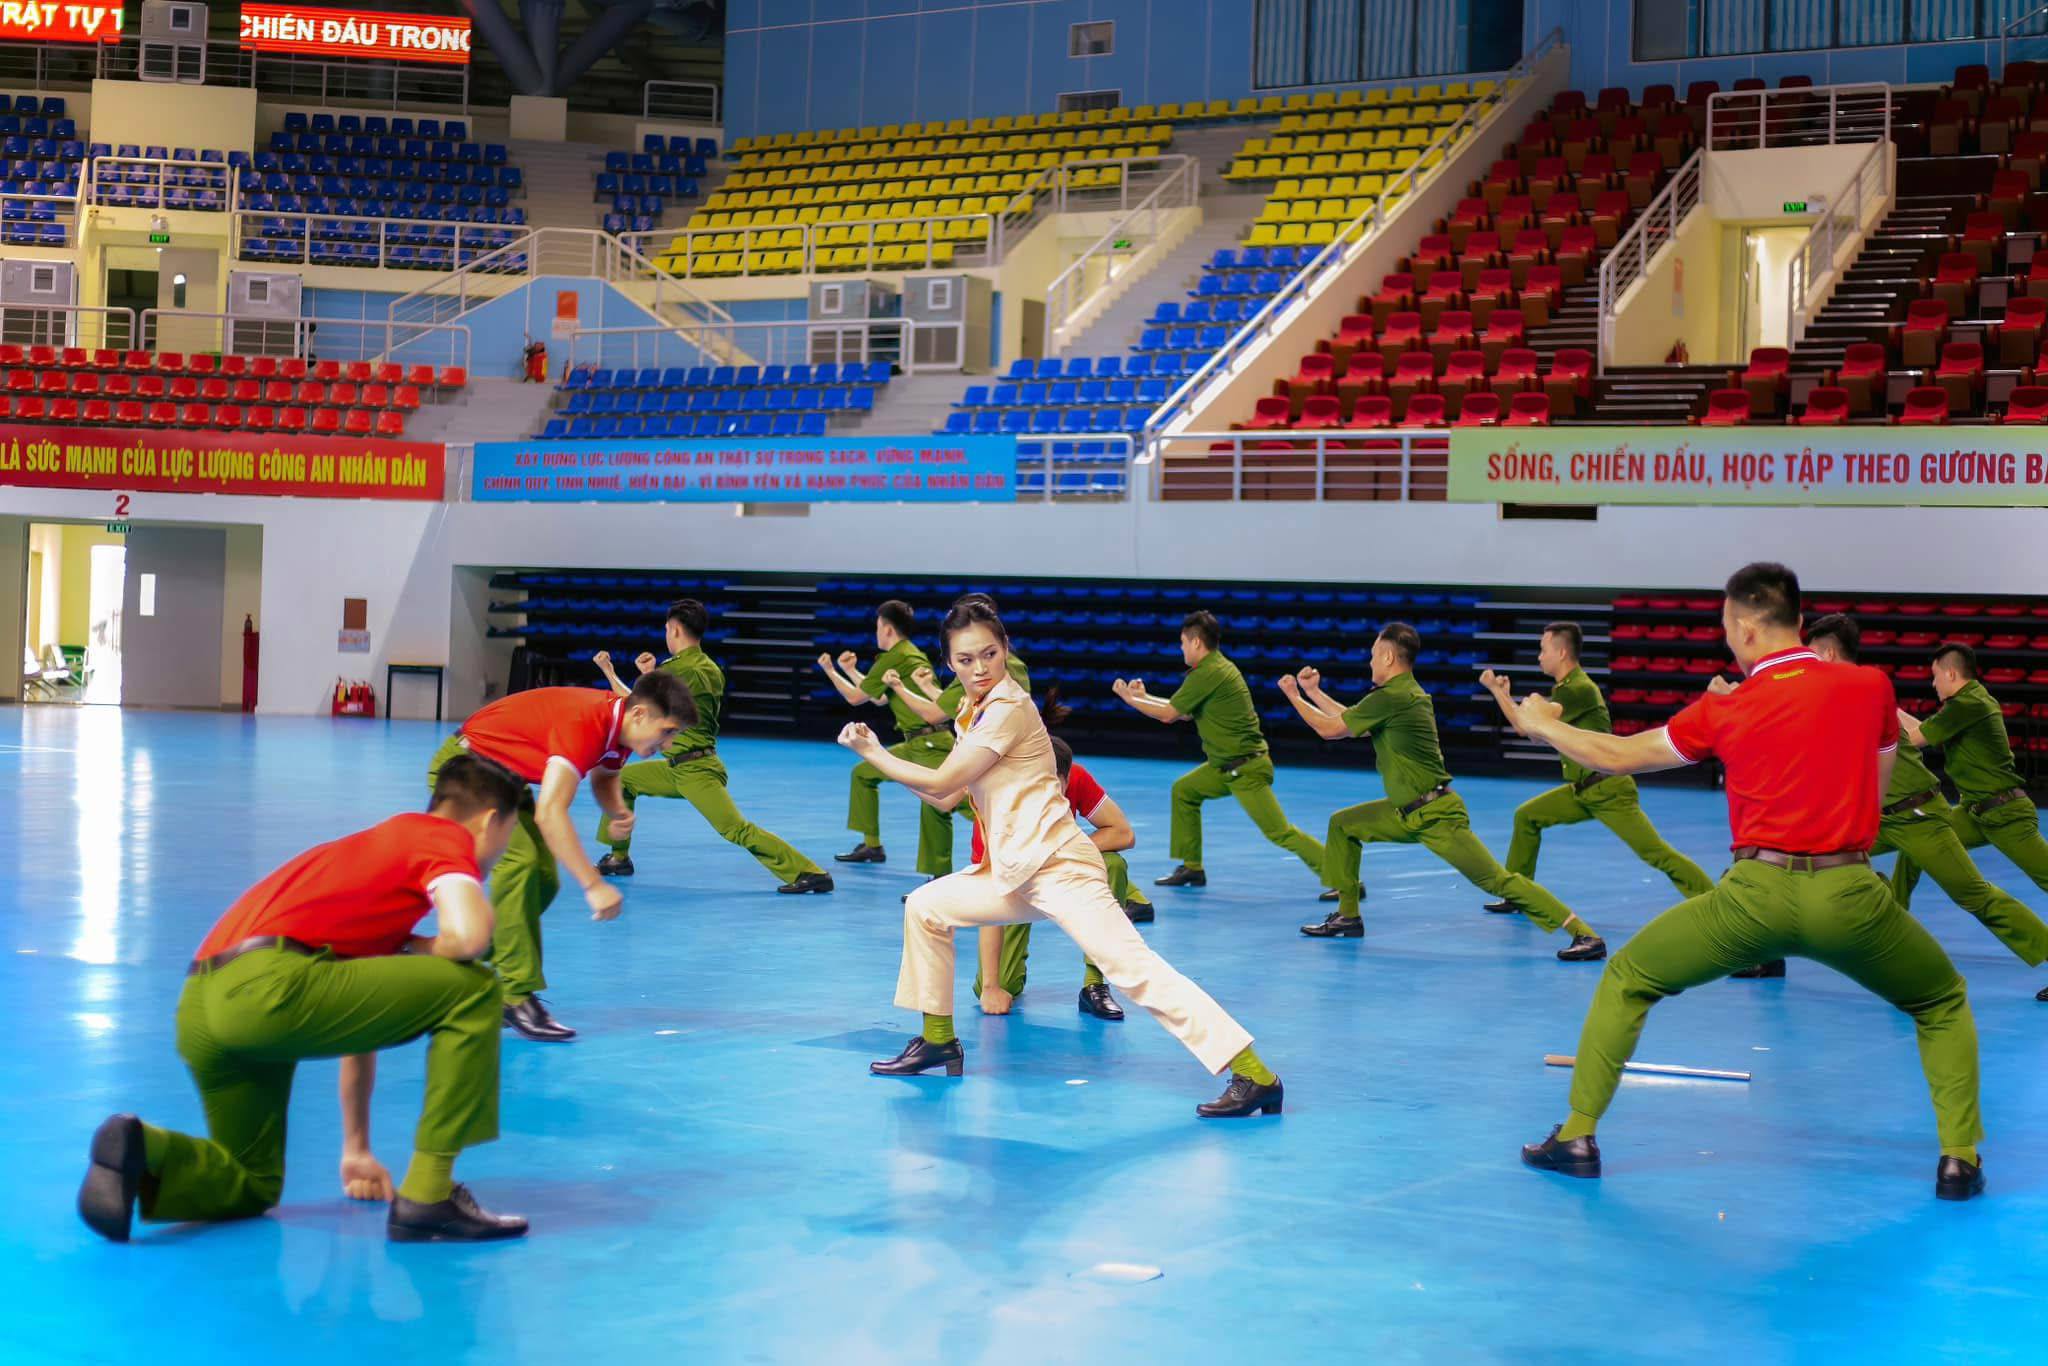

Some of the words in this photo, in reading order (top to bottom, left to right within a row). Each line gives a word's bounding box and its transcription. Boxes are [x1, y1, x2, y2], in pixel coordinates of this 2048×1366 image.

[0, 0, 58, 32] RẬT
[65, 5, 106, 36] TỰ
[0, 437, 20, 471] LÀ
[26, 438, 61, 472] SỨC
[65, 445, 117, 479] MẠNH
[121, 439, 157, 476] CỦA
[161, 448, 194, 483] LỰC
[198, 448, 255, 485] LƯỢNG
[259, 448, 306, 482] CÔNG
[310, 455, 335, 482] AN
[339, 450, 387, 485] NHÂN
[391, 452, 427, 487] DÂN
[1487, 441, 1560, 485] SỐNG,
[1570, 442, 1645, 482] CHIẾN
[1654, 441, 1713, 488] ĐẤU,
[1722, 453, 1775, 491] HỌC
[1784, 447, 1834, 491] TẬP
[1843, 454, 1910, 484] THEO
[1920, 450, 2016, 484] GƯƠNG
[2025, 453, 2048, 485] B
[115, 495, 129, 515] 2
[110, 523, 131, 533] EXIT
